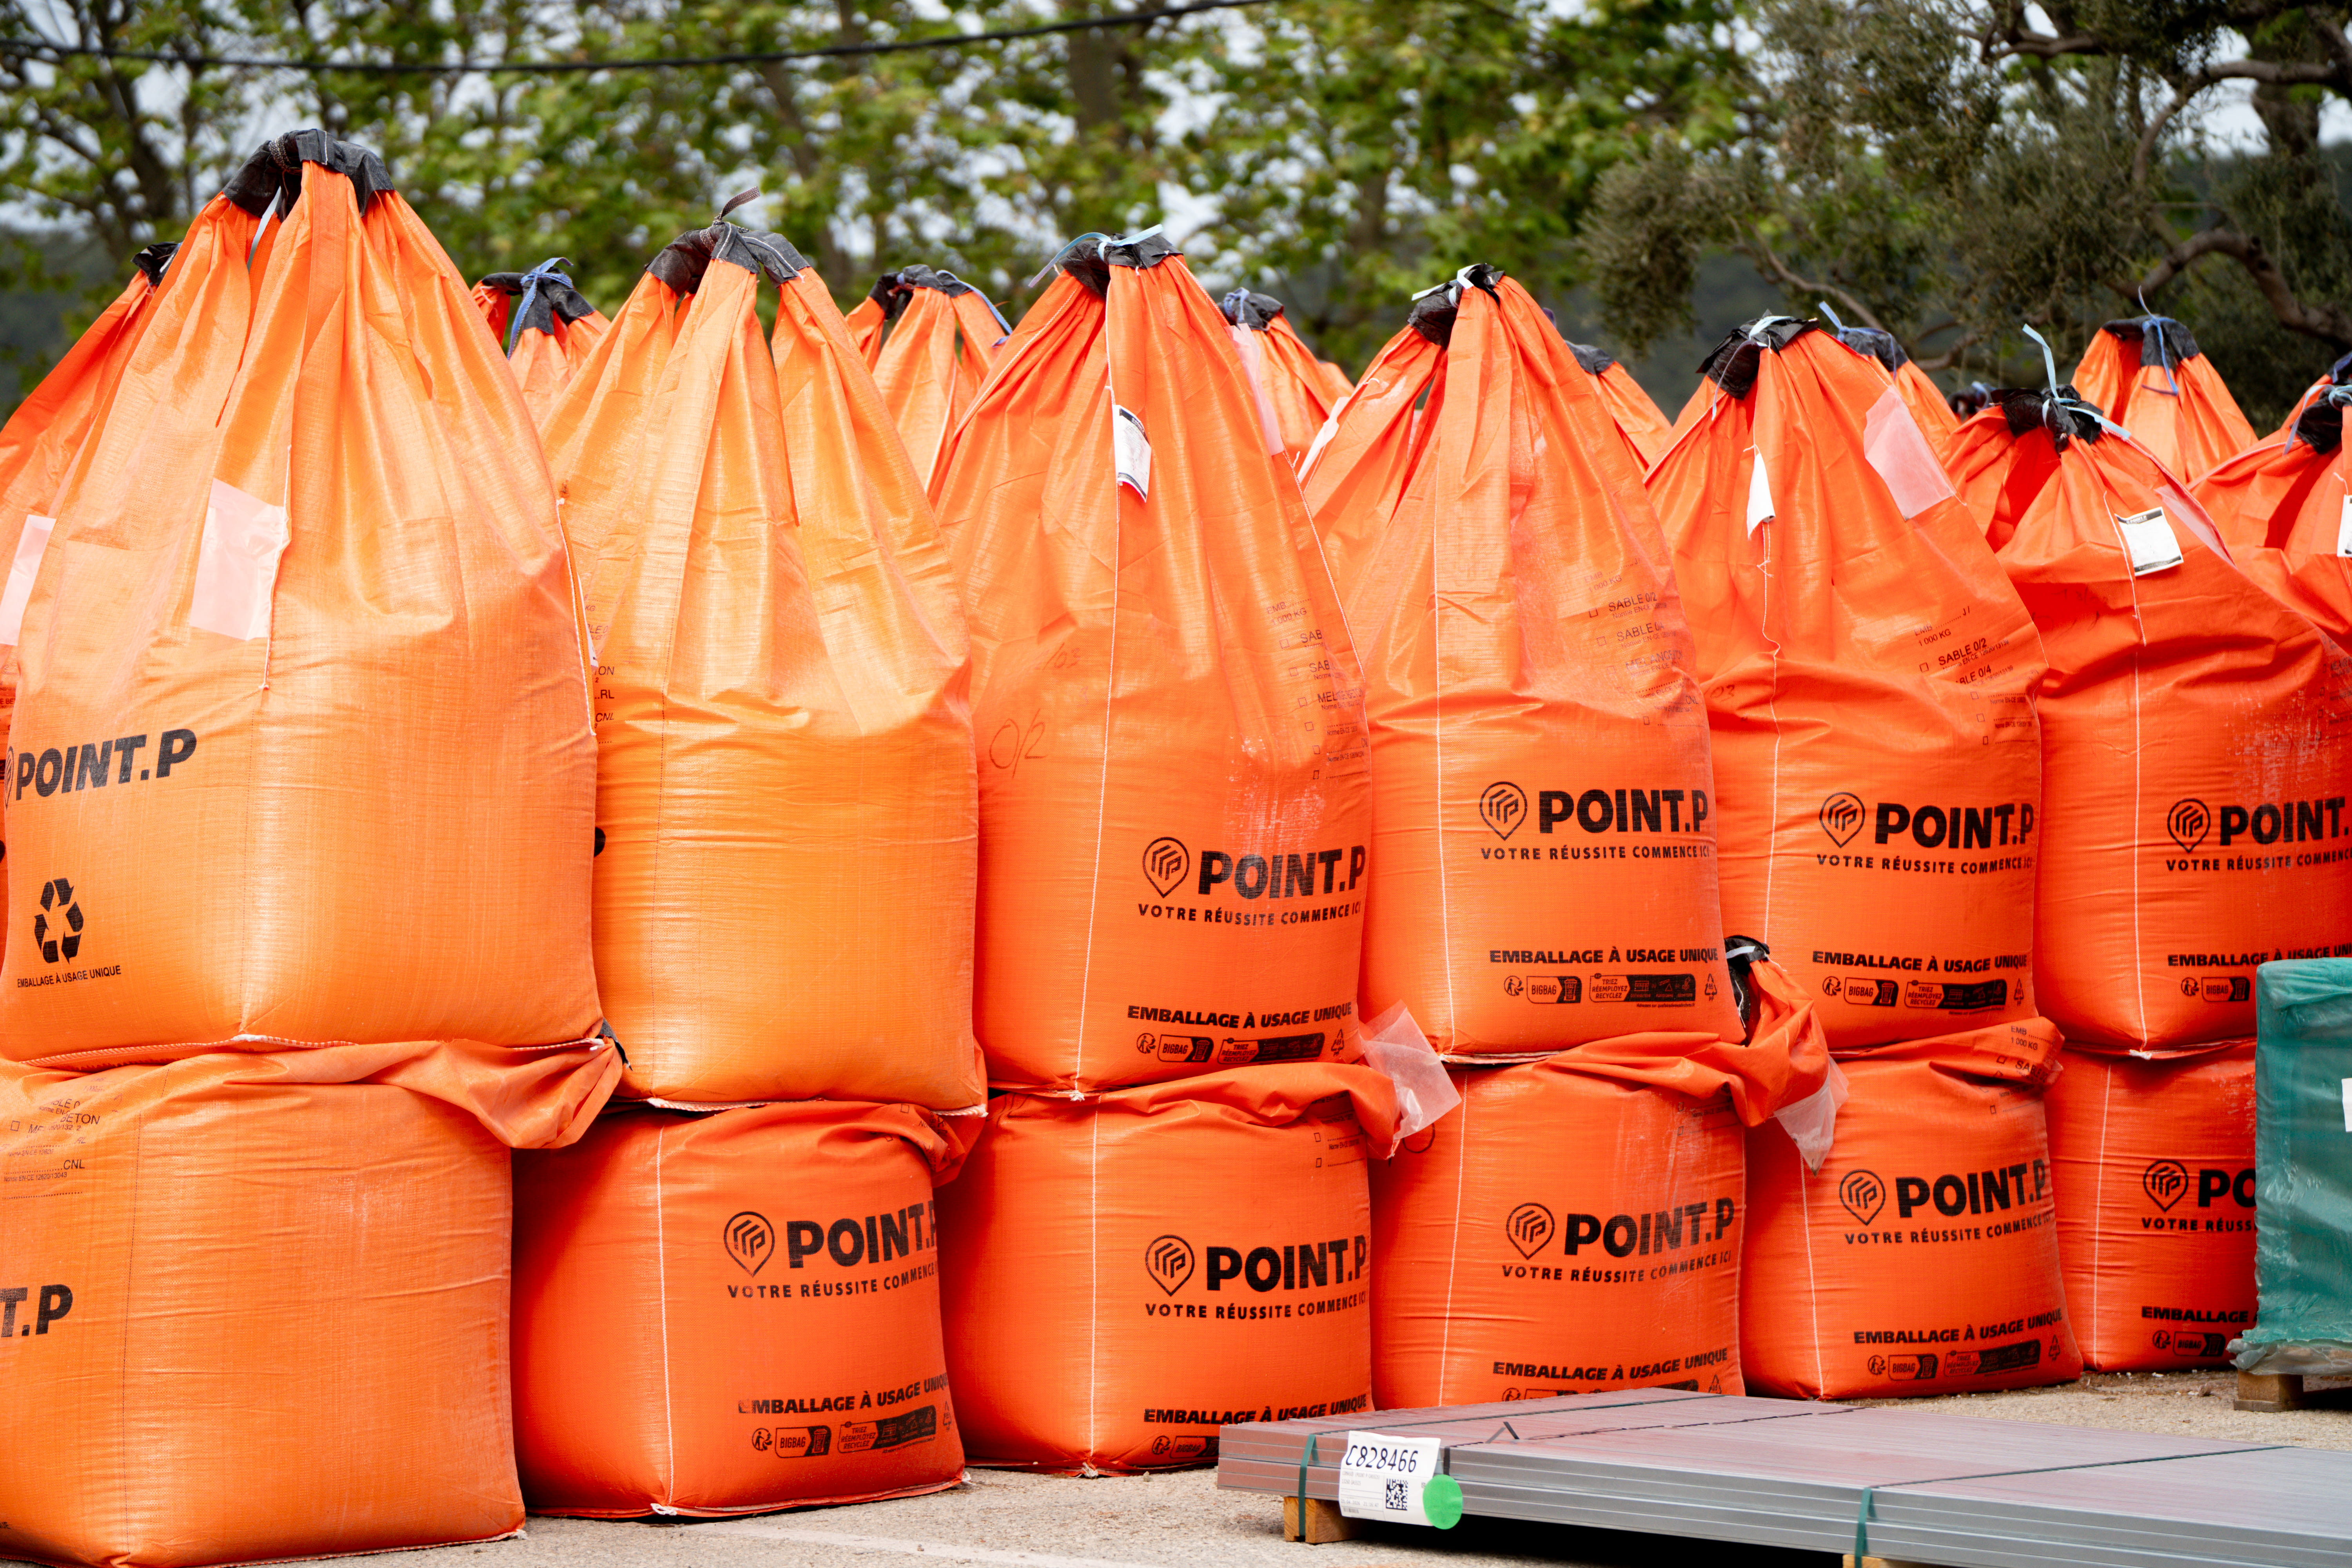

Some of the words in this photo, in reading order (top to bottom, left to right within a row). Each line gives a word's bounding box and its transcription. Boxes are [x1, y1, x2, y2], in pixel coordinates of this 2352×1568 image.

[1610, 575, 1622, 584] KG
[1267, 602, 1287, 615] EMB
[1609, 594, 1643, 612] SABLE
[1645, 592, 1657, 602] 0/2
[1294, 608, 1307, 617] KG
[1300, 630, 1322, 643] SAB
[1617, 622, 1653, 641] SABLE
[1924, 634, 1938, 644] 000
[1939, 628, 1951, 639] KG
[1938, 644, 1972, 666] SABLE
[1973, 638, 1987, 651] 0/2
[1963, 652, 1978, 664] EN-CE
[1978, 664, 1991, 677] 0/4
[1686, 695, 1699, 705] CNL
[596, 713, 614, 722] CNL
[989, 708, 1047, 779] 0/2
[16, 729, 196, 800] POINT.P
[1539, 789, 1708, 833] POINT.P
[1875, 802, 2034, 849] POINT.P
[2220, 796, 2352, 846] POINT.
[1481, 848, 1540, 860] VOTRE
[1550, 845, 1626, 860] RÉUSSITE
[1633, 846, 1697, 858] COMMENCE
[1700, 846, 1709, 858] ICI
[1817, 854, 1873, 869] VOTRE
[1882, 856, 1955, 873] RÉUSSITE
[1960, 857, 2022, 874] COMMENCE
[2024, 857, 2032, 868] ICI
[2166, 859, 2220, 871] VOTRE
[2227, 855, 2291, 871] RÉUSSITE
[1198, 845, 1366, 900] POINT.P
[1138, 903, 1196, 922] VOTRE
[1205, 907, 1274, 926] RÉUSSITE
[1281, 906, 1349, 926] COMMENCE
[1352, 902, 1361, 915] ICI
[1490, 950, 1603, 964] EMBALLAGE
[1608, 946, 1621, 962] À
[1626, 949, 1675, 962] USAGE
[1680, 948, 1718, 962] UNIQUE
[1812, 950, 1922, 971] EMBALLAGE
[1927, 956, 1938, 971] À
[1943, 958, 1991, 973] USAGE
[1994, 954, 2027, 970] UNIQUE
[2167, 953, 2268, 967] EMBALLAGE
[2288, 946, 2329, 960] USAGE
[18, 975, 54, 988] EMBALLAGE
[56, 972, 61, 983] À
[62, 971, 88, 982] USAGE
[89, 965, 121, 979] UNIQUE
[1532, 985, 1556, 995] BIGBAG
[1848, 986, 1874, 998] BIGBAG
[2206, 984, 2229, 995] BIGBAG
[1127, 1005, 1240, 1029] EMBALLAGE
[1243, 1012, 1256, 1029] À
[1261, 1010, 1310, 1028] USAGE
[1314, 1001, 1352, 1022] UNIQUE
[2011, 1025, 2027, 1035] EMB
[1162, 1043, 1188, 1054] BIGBAG
[2016, 1038, 2027, 1047] 000
[2028, 1041, 2038, 1050] KG
[60, 1113, 100, 1124] BETON
[64, 1159, 85, 1170] CNL
[36, 1172, 67, 1180] 12620/13043
[1896, 1158, 2046, 1218] POINT.P
[1564, 1197, 1735, 1258] POINT.P
[1845, 1231, 1902, 1244] VOTRE
[1910, 1228, 1981, 1243] RÉUSSITE
[1987, 1215, 2042, 1238] COMMENCE
[2142, 1218, 2198, 1231] VOTRE
[1207, 1235, 1366, 1292] POINT.P
[1502, 1265, 1562, 1280] VOTRE
[1570, 1266, 1644, 1283] RÉUSSITE
[1651, 1253, 1717, 1280] COMMENCE
[1720, 1250, 1731, 1263] ICI
[727, 1285, 791, 1298] VOTRE
[800, 1279, 877, 1298] RÉUSSITE
[884, 1265, 934, 1290] COMMENCE
[1145, 1303, 1207, 1318] VOTRE
[1216, 1303, 1291, 1320] RÉUSSITE
[1298, 1296, 1357, 1316] COMMENCE
[2141, 1306, 2248, 1323] EMBALLAGE
[1854, 1329, 1959, 1344] EMBALLAGE
[1964, 1324, 1975, 1341] À
[1980, 1320, 2024, 1339] USAGE
[2027, 1308, 2062, 1329] UNIQUE
[2178, 1339, 2201, 1349] BIGBAG
[1493, 1362, 1607, 1381] EMBALLAGE
[1612, 1364, 1624, 1380] À
[1629, 1358, 1680, 1378] USAGE
[1685, 1347, 1728, 1370] UNIQUE
[739, 1396, 855, 1414] EMBALLAGE
[859, 1391, 872, 1409] À
[877, 1381, 920, 1406] USAGE
[1144, 1408, 1256, 1424] EMBALLAGE
[1259, 1406, 1272, 1422] À
[1279, 1401, 1326, 1421] USAGE
[1331, 1394, 1367, 1415] UNIQUE
[780, 1436, 806, 1449] BIGBAG
[841, 1432, 876, 1443] RÉEMPLOYEZ
[843, 1440, 870, 1450] RECYCLEZ
[1346, 1445, 1418, 1472] C828466
